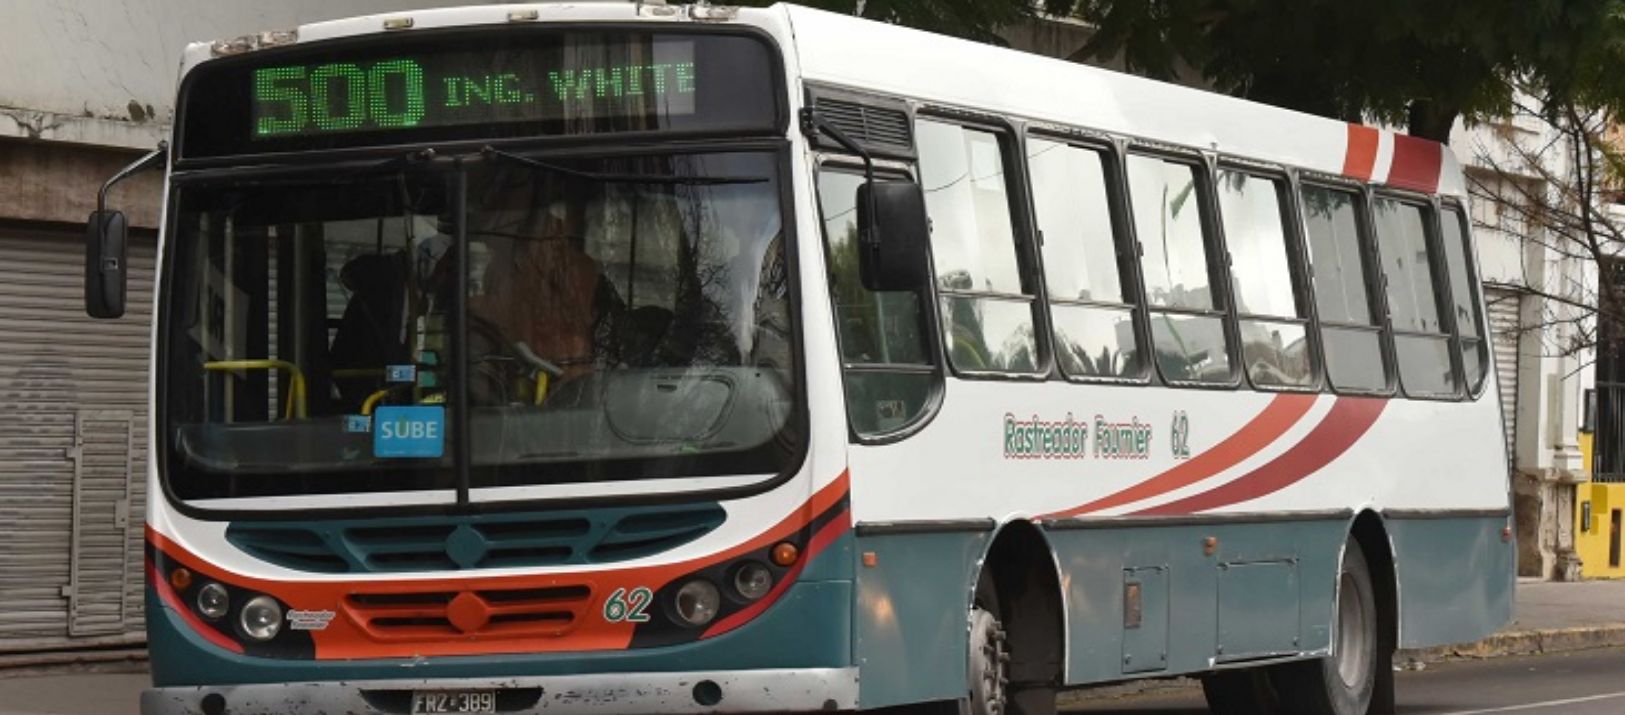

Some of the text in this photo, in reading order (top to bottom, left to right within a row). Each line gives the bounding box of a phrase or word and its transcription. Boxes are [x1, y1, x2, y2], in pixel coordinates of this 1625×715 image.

[256, 59, 695, 136] 500 ING. WHITE
[380, 421, 438, 439] SUBE
[1003, 409, 1190, 460] Rastreador Fournier 62
[603, 586, 654, 623] 62
